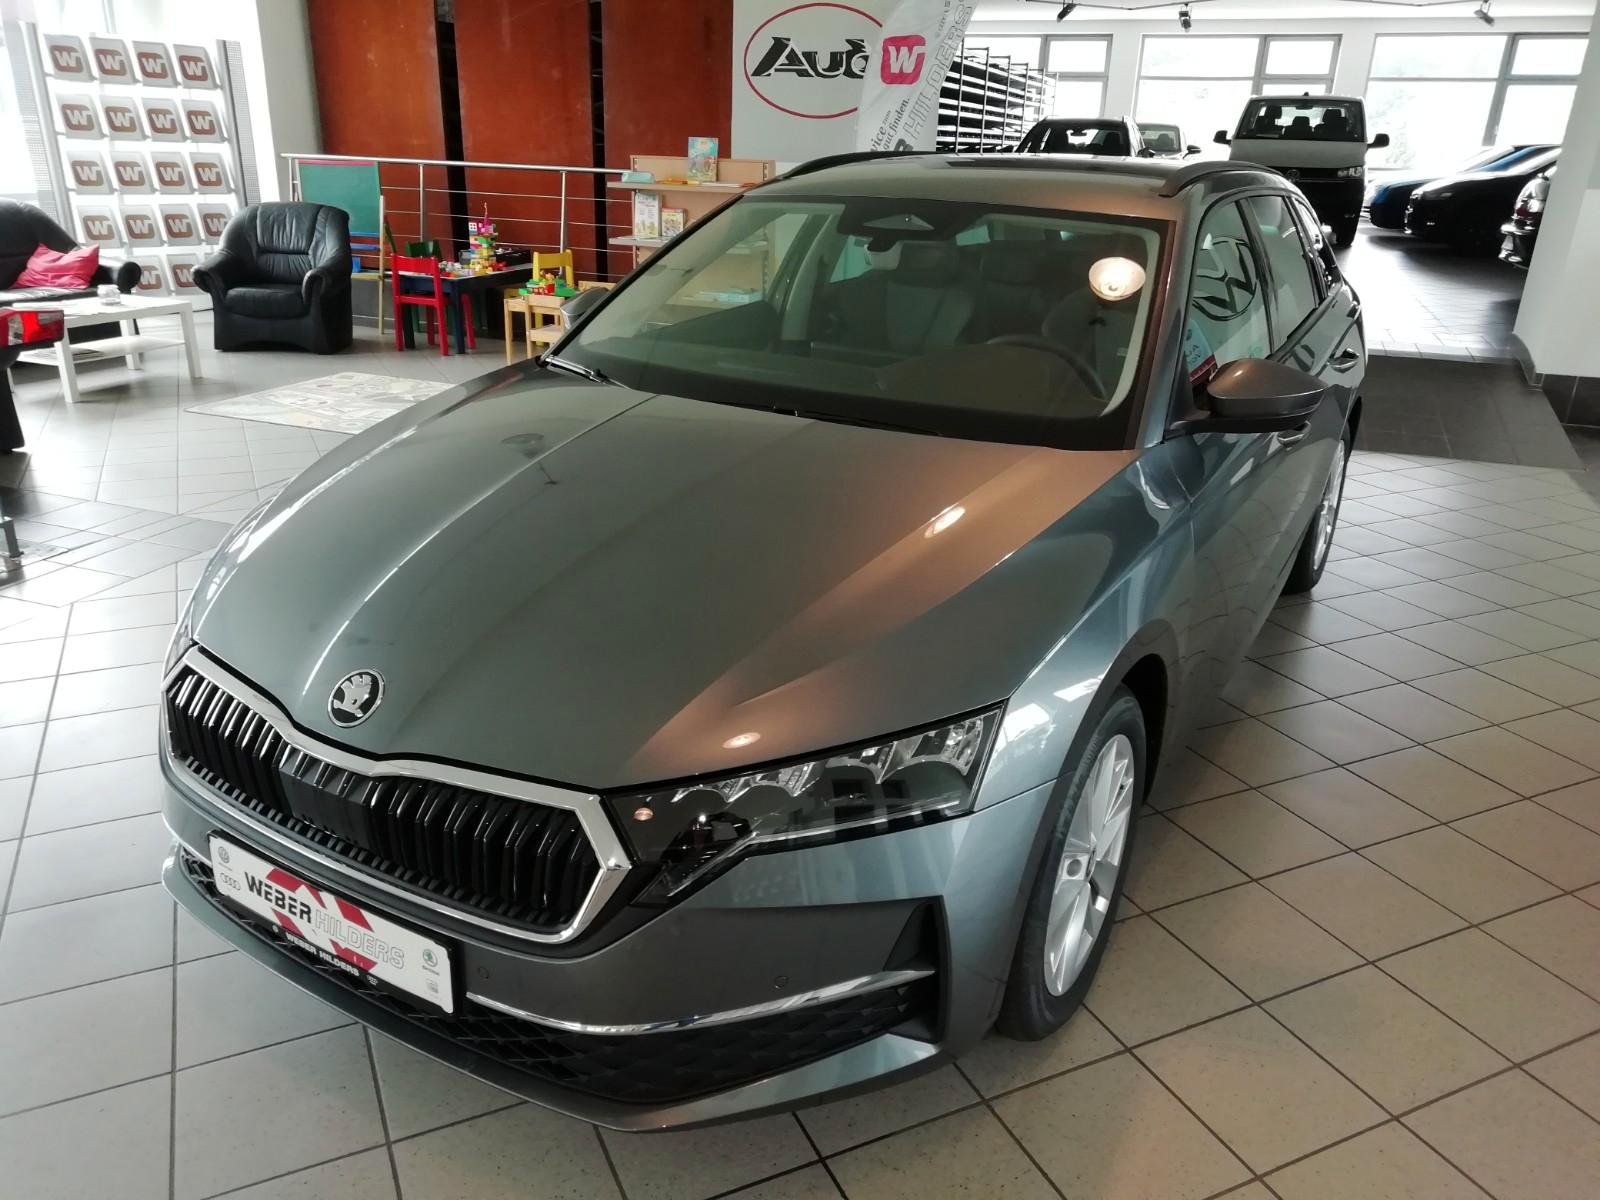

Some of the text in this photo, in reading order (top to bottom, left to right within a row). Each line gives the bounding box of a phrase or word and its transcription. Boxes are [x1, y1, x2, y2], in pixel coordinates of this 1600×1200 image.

[244, 871, 405, 970] WEBER HILDERS
[319, 950, 360, 977] HILDERS
